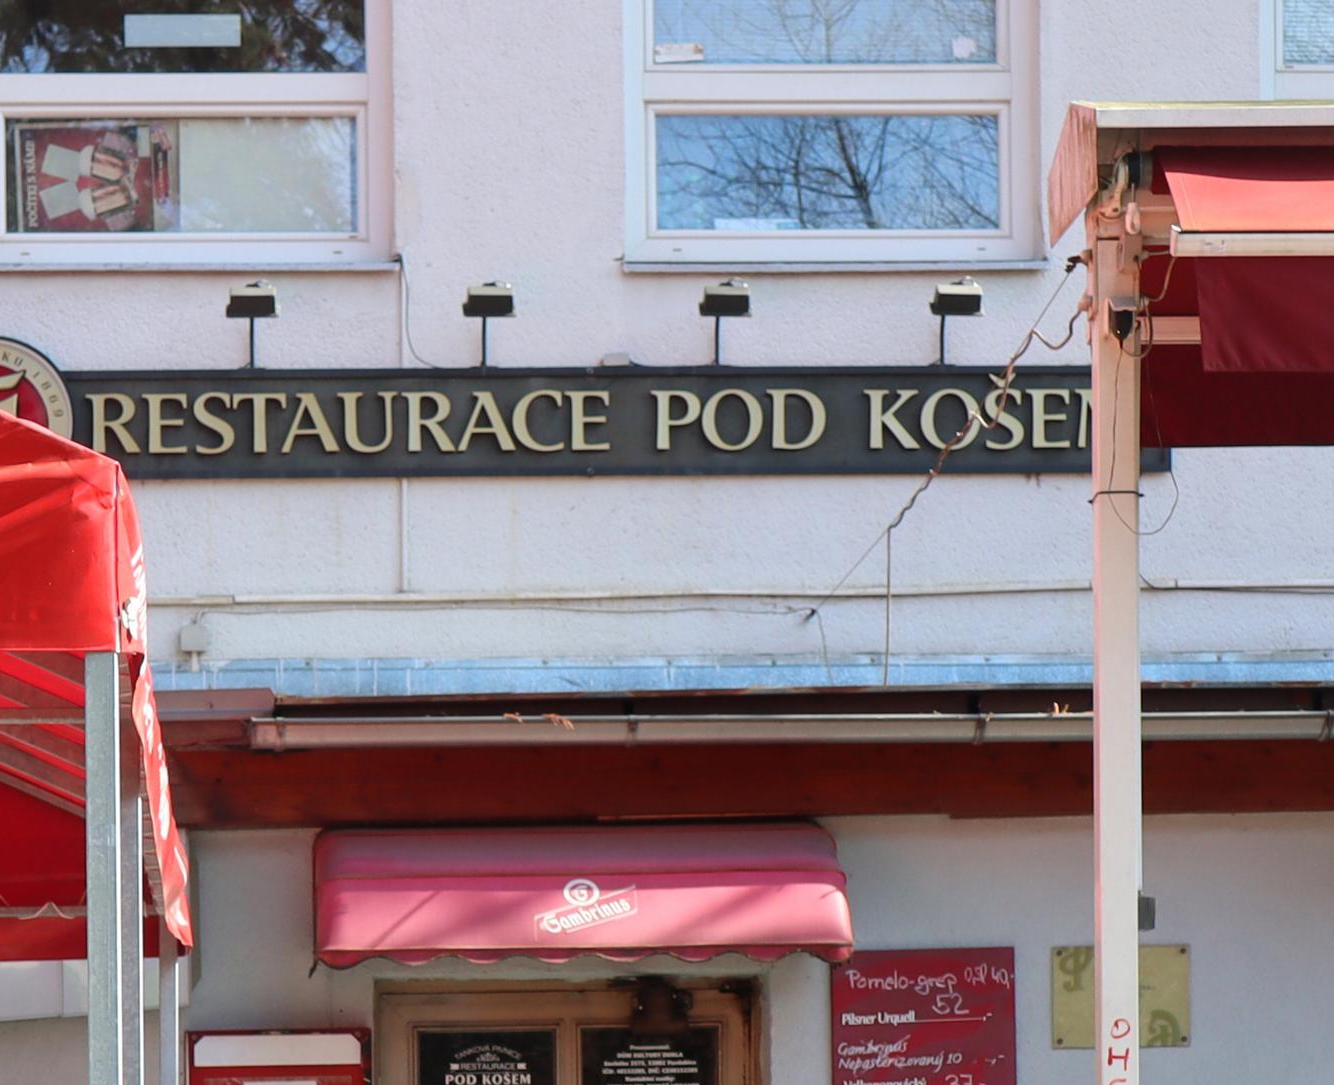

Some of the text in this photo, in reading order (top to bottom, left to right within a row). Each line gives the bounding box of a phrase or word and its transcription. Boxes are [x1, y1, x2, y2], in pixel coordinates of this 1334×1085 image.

[85, 373, 1093, 455] RESTAURACE POD KOŠE
[539, 898, 631, 934] Gambrinus
[931, 992, 970, 1015] 52
[841, 1010, 916, 1027] Pilsner Urquell
[445, 1071, 532, 1085] POD KOŠEM
